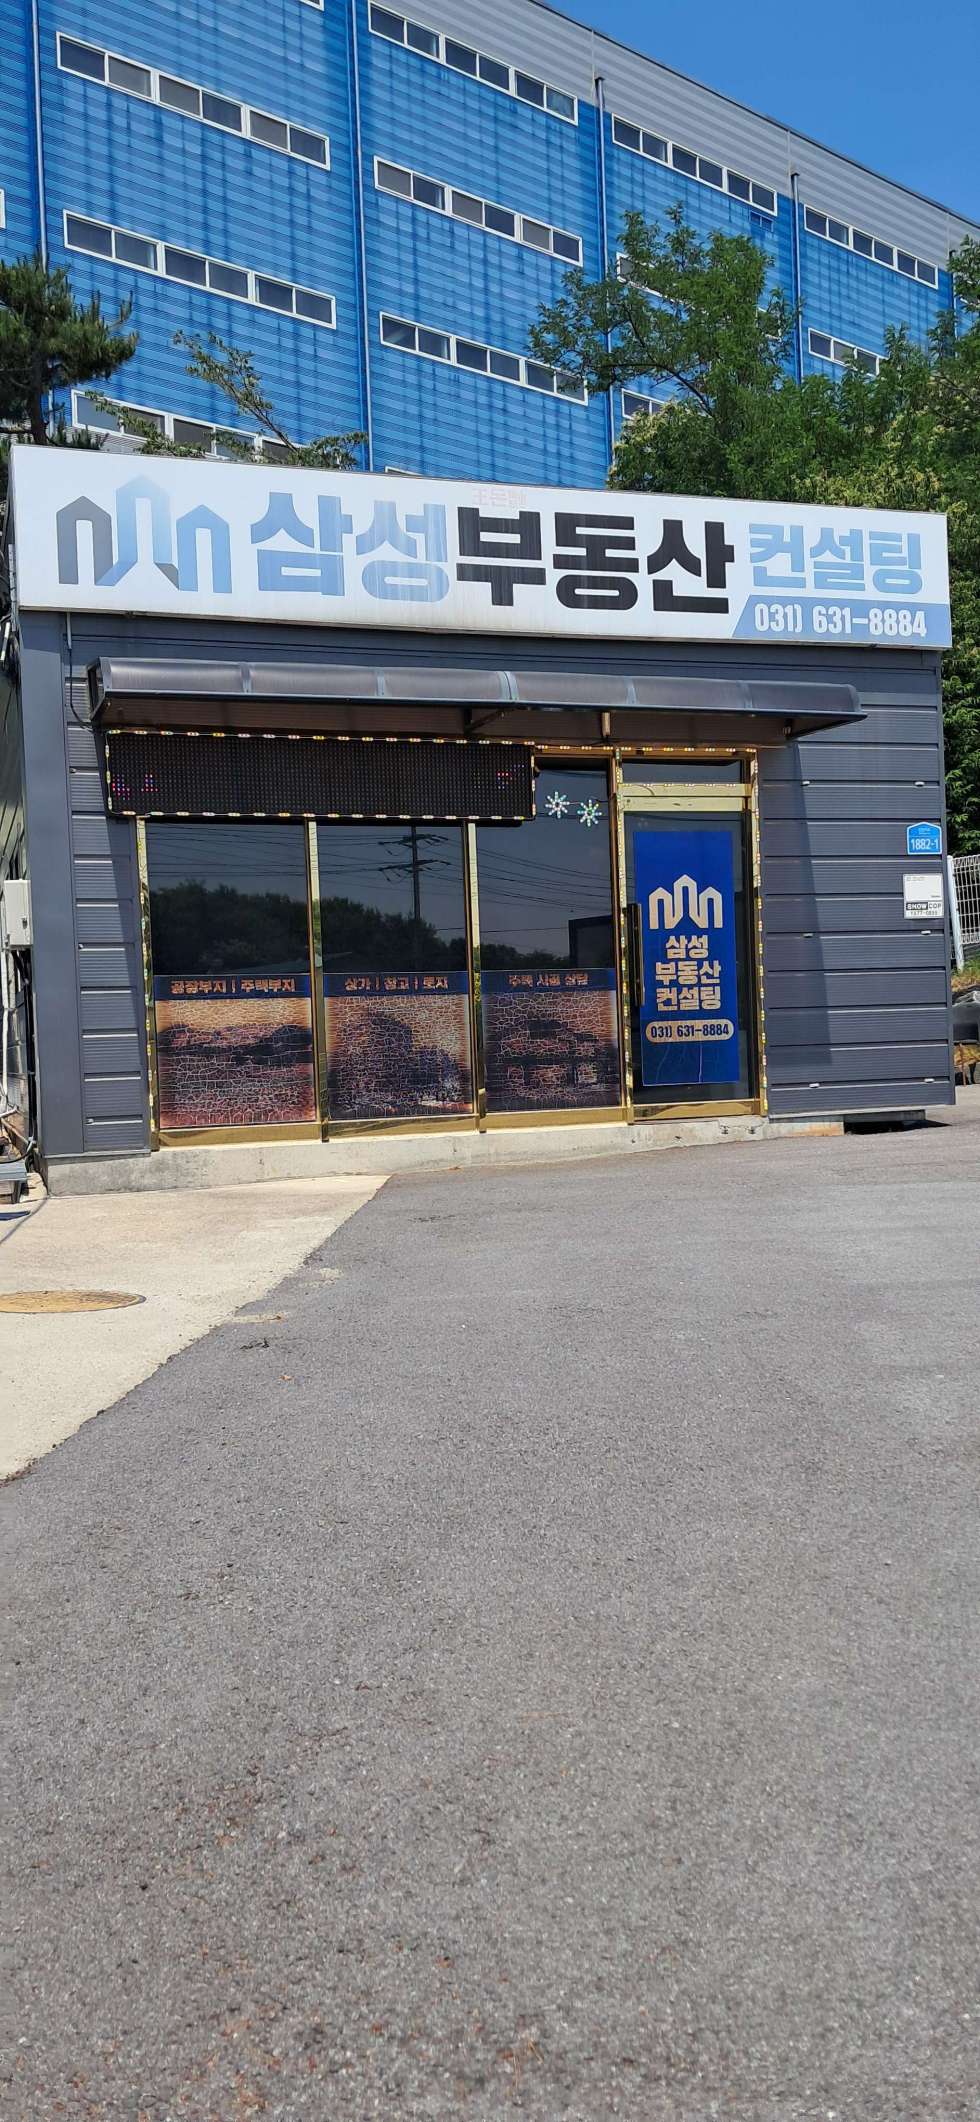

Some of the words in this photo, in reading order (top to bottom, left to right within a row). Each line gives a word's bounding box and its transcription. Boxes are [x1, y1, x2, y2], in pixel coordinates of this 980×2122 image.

[748, 522, 923, 595] 컨설팅
[754, 602, 803, 634] 031)
[812, 604, 928, 637] 631-8884
[911, 838, 939, 851] 1882-1
[665, 934, 709, 960] 삼성
[240, 978, 296, 993] 주택부지
[655, 960, 721, 986] 부동산
[655, 985, 722, 1011] 컨설팅
[650, 1025, 673, 1039] 031)
[676, 1023, 730, 1038] 631-8884
